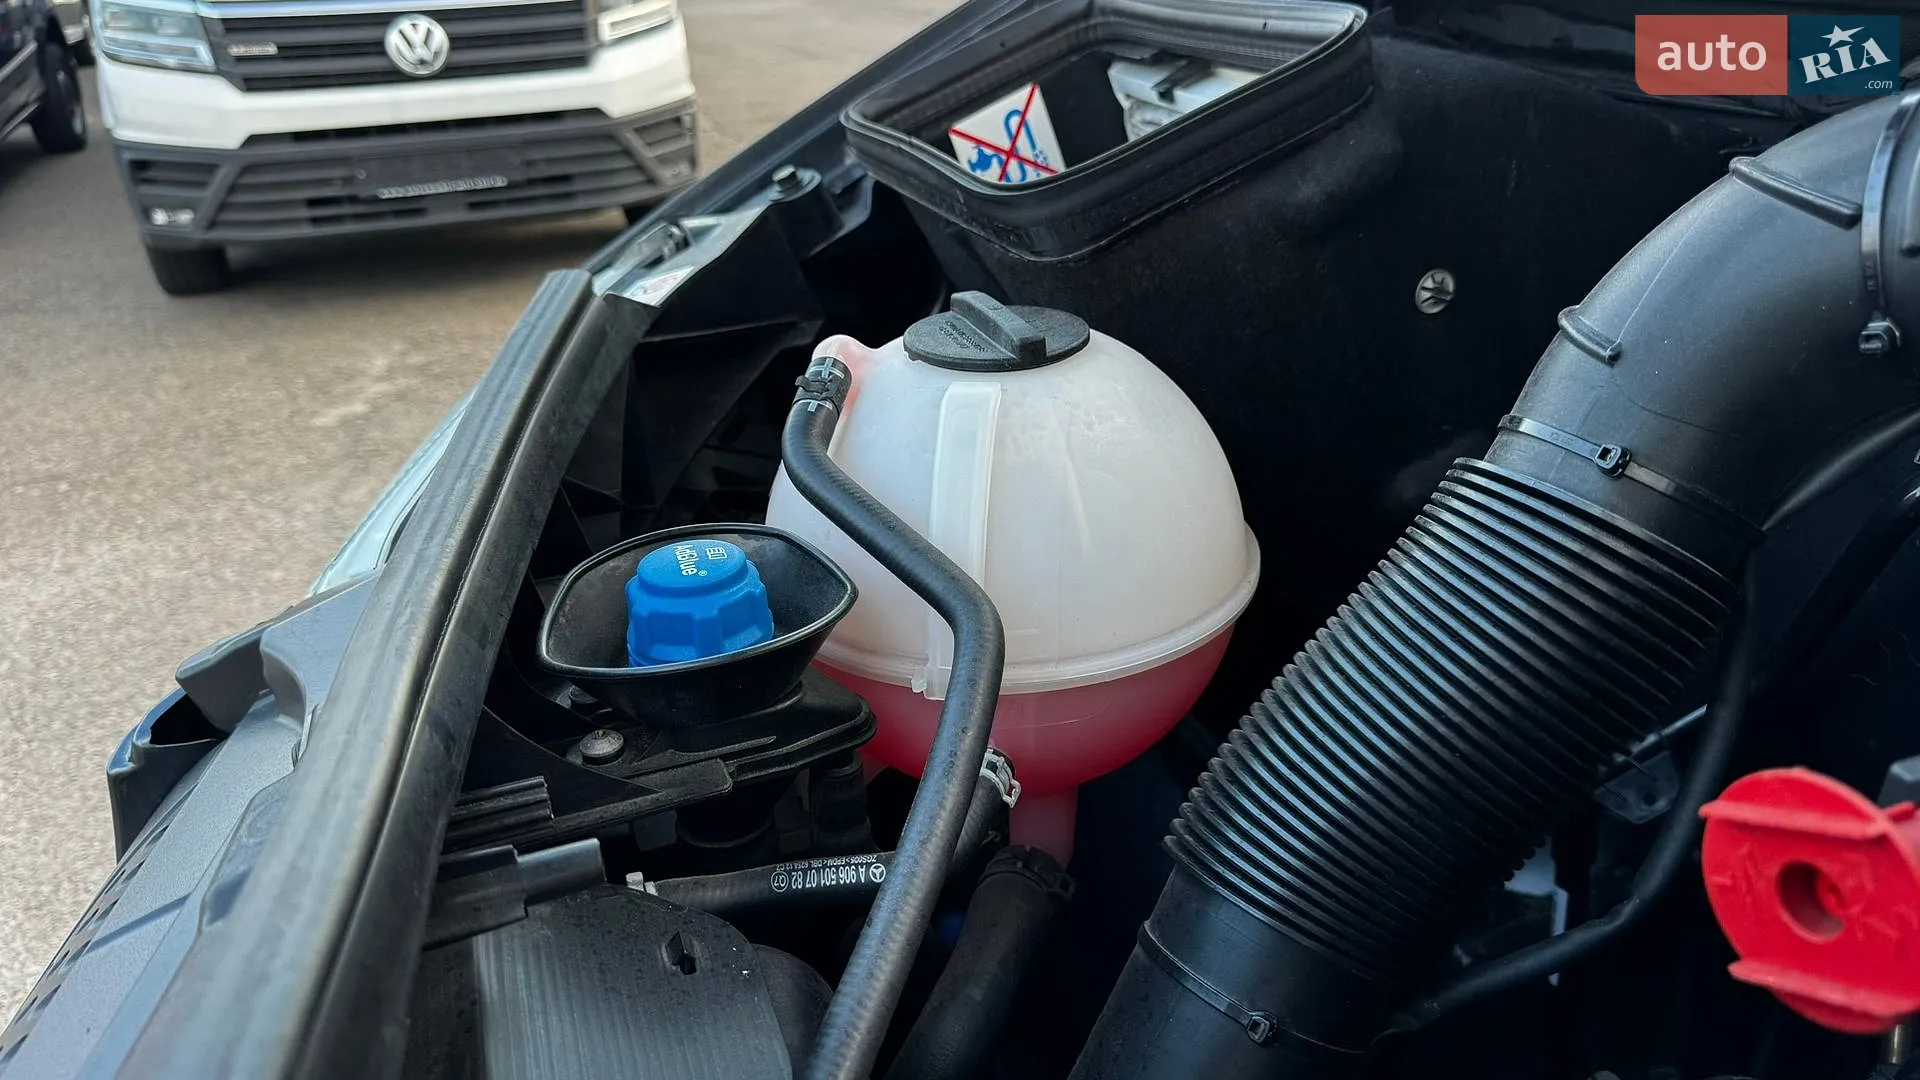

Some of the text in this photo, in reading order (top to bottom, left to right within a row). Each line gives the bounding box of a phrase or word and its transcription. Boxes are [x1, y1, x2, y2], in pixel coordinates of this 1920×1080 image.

[388, 15, 447, 73] VW
[791, 871, 803, 889] 82
[806, 870, 818, 888] 07
[821, 868, 837, 888] 501
[838, 866, 857, 885] 906
[857, 864, 866, 883] A
